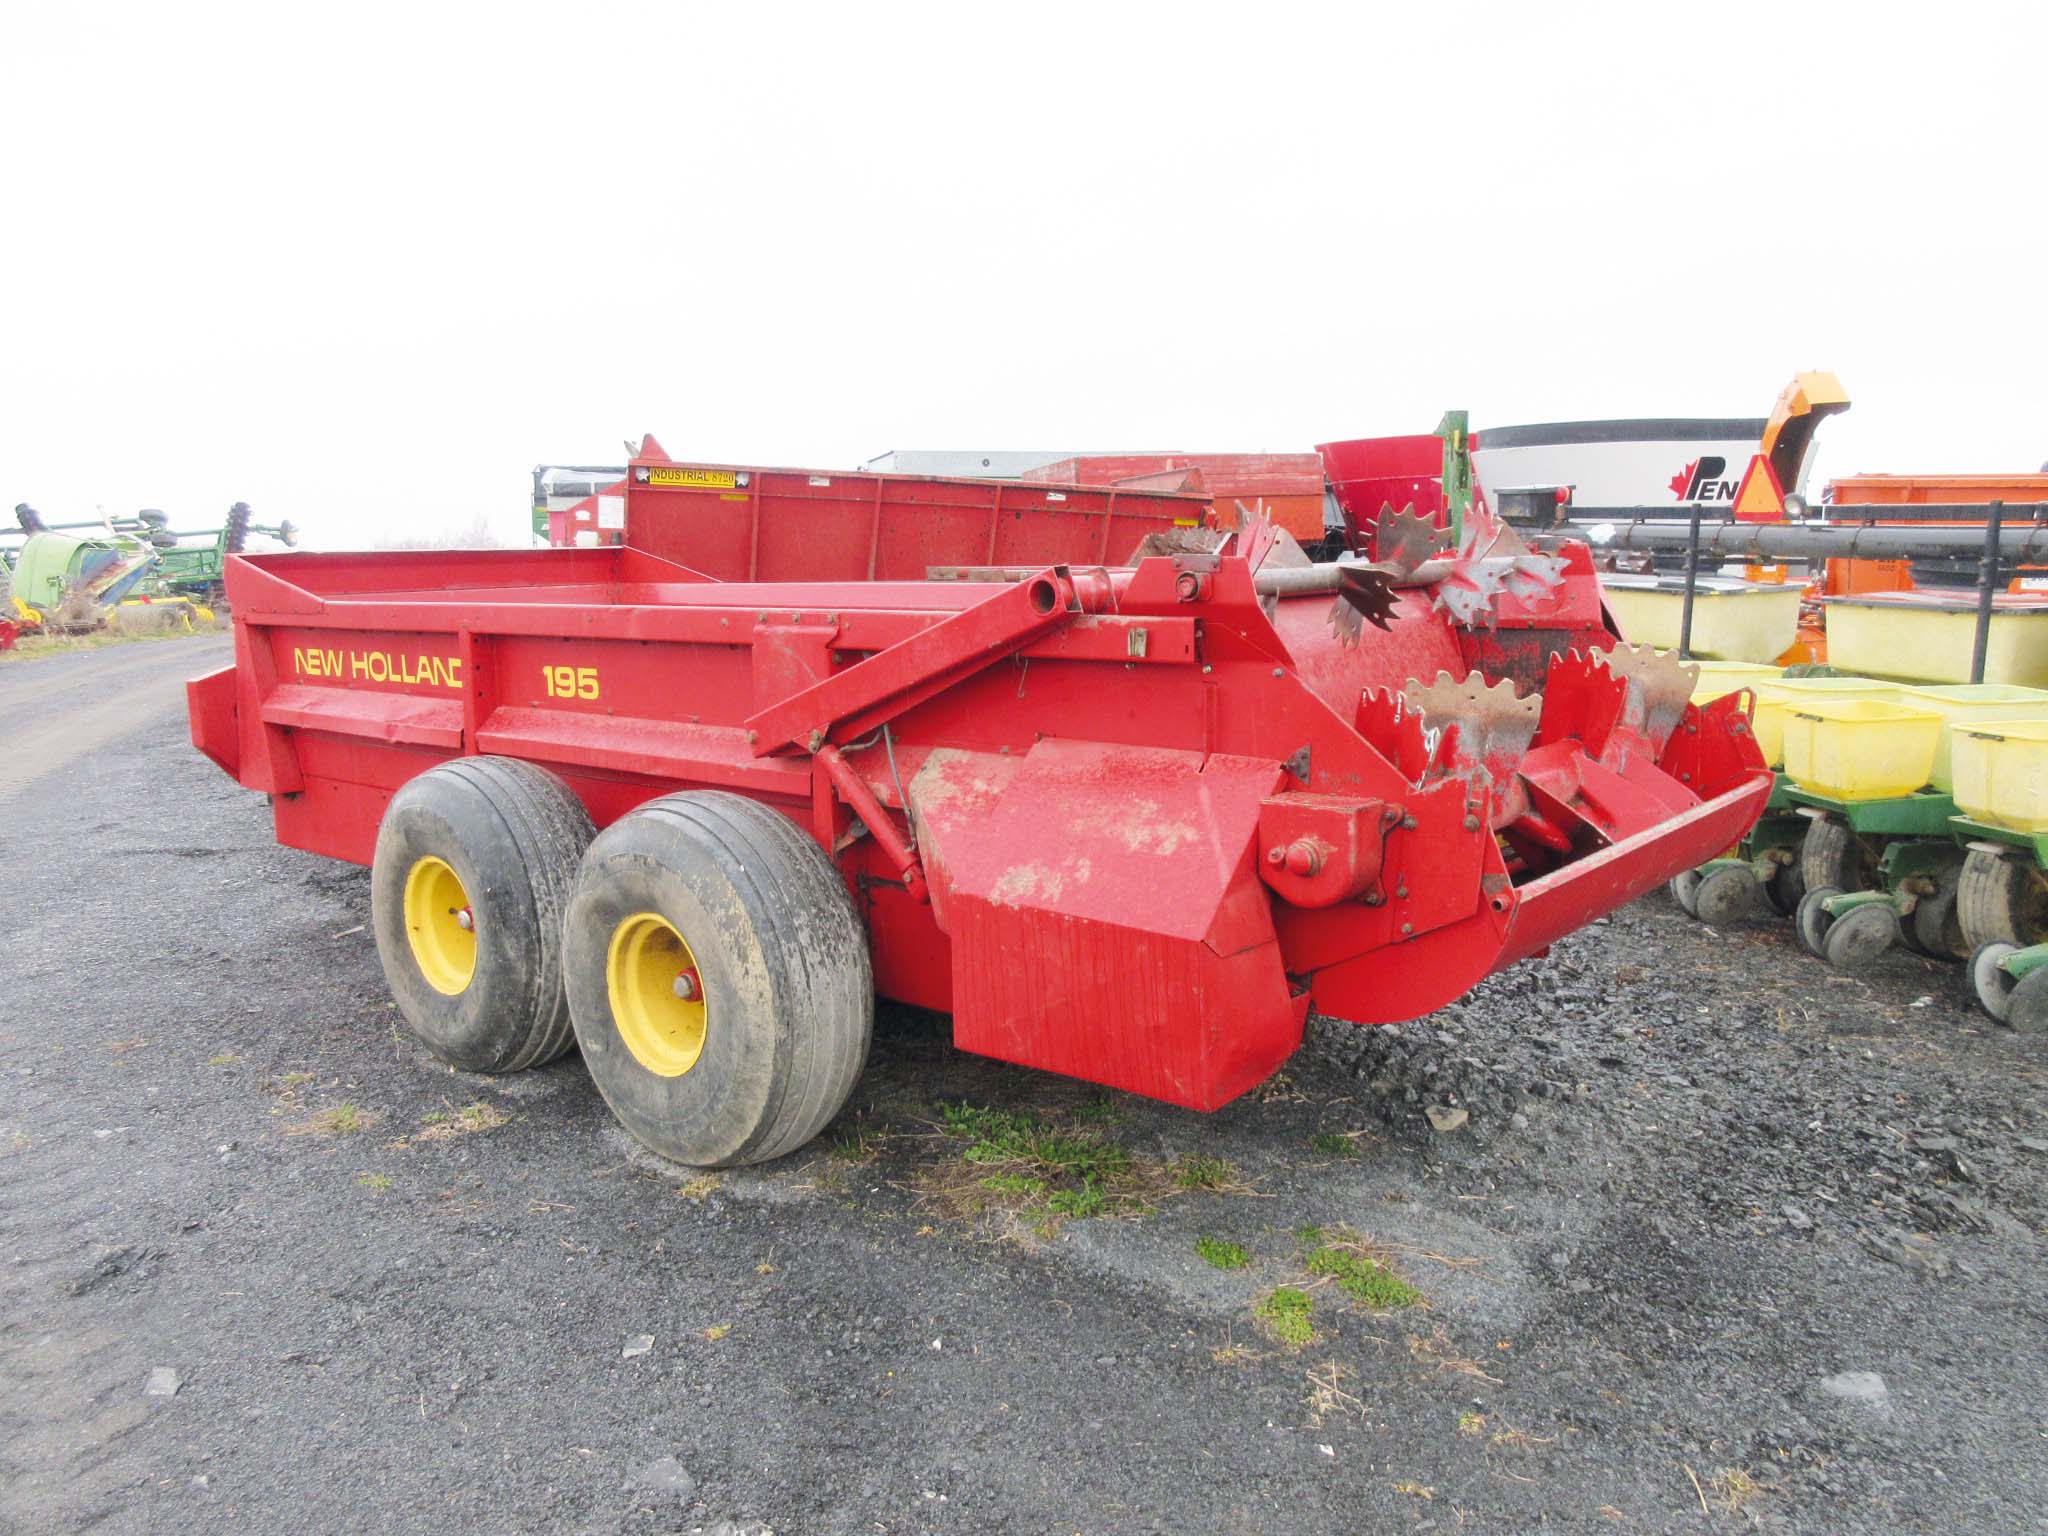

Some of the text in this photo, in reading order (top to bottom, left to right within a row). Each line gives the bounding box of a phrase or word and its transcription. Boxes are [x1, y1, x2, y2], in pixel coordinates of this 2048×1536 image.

[651, 467, 709, 481] INDUSTRIAL
[294, 647, 344, 677] NEW
[542, 665, 599, 700] 195
